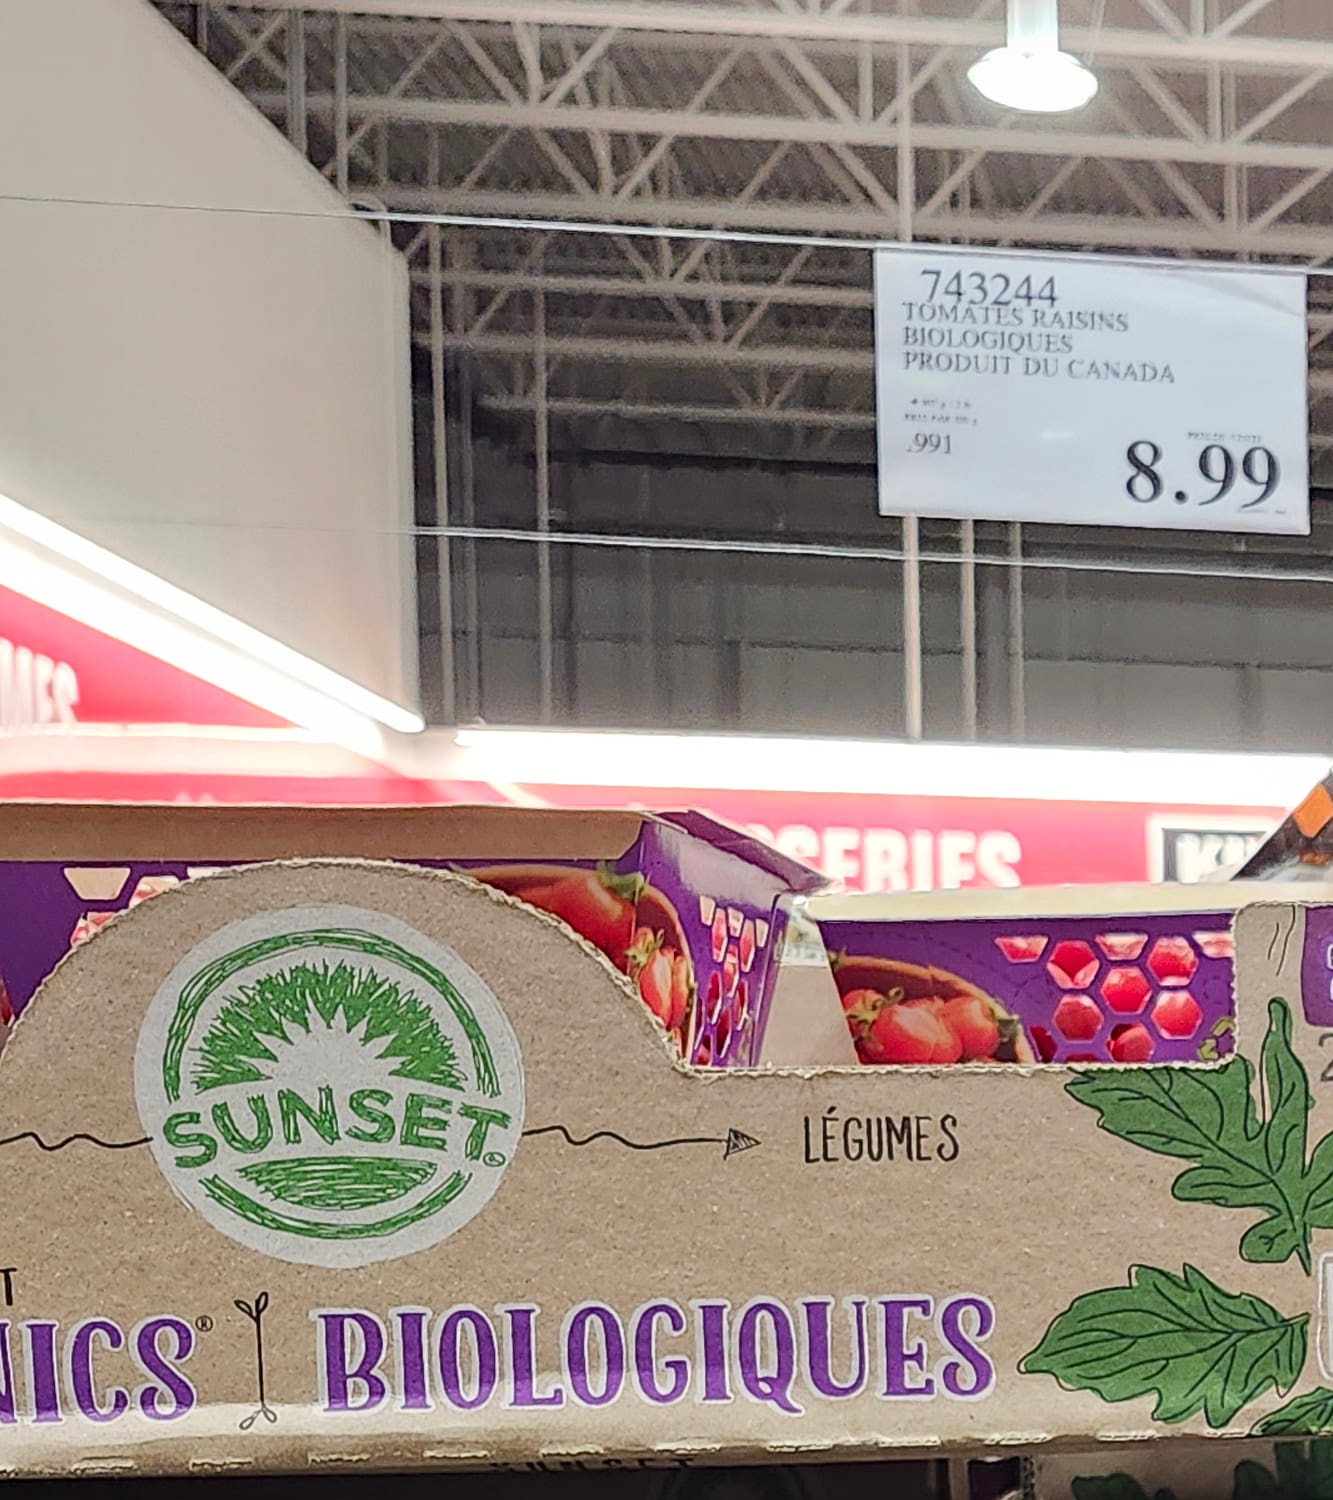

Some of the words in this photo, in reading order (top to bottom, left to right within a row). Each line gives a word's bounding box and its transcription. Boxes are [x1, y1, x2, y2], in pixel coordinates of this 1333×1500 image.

[920, 270, 1059, 307] 743244
[902, 303, 1023, 326] TOMATES
[1032, 309, 1129, 332] RAISINS
[902, 327, 1073, 354] BIOLOGIQUES
[903, 352, 1011, 375] PRODUIT
[1023, 357, 1058, 377] DU
[1068, 359, 1175, 383] CANADA
[1126, 440, 1281, 508] 8.99
[162, 1084, 511, 1169] SUNSET
[802, 1106, 960, 1163] LÉGUMES
[314, 1294, 995, 1416] BIOLOGIQUES
